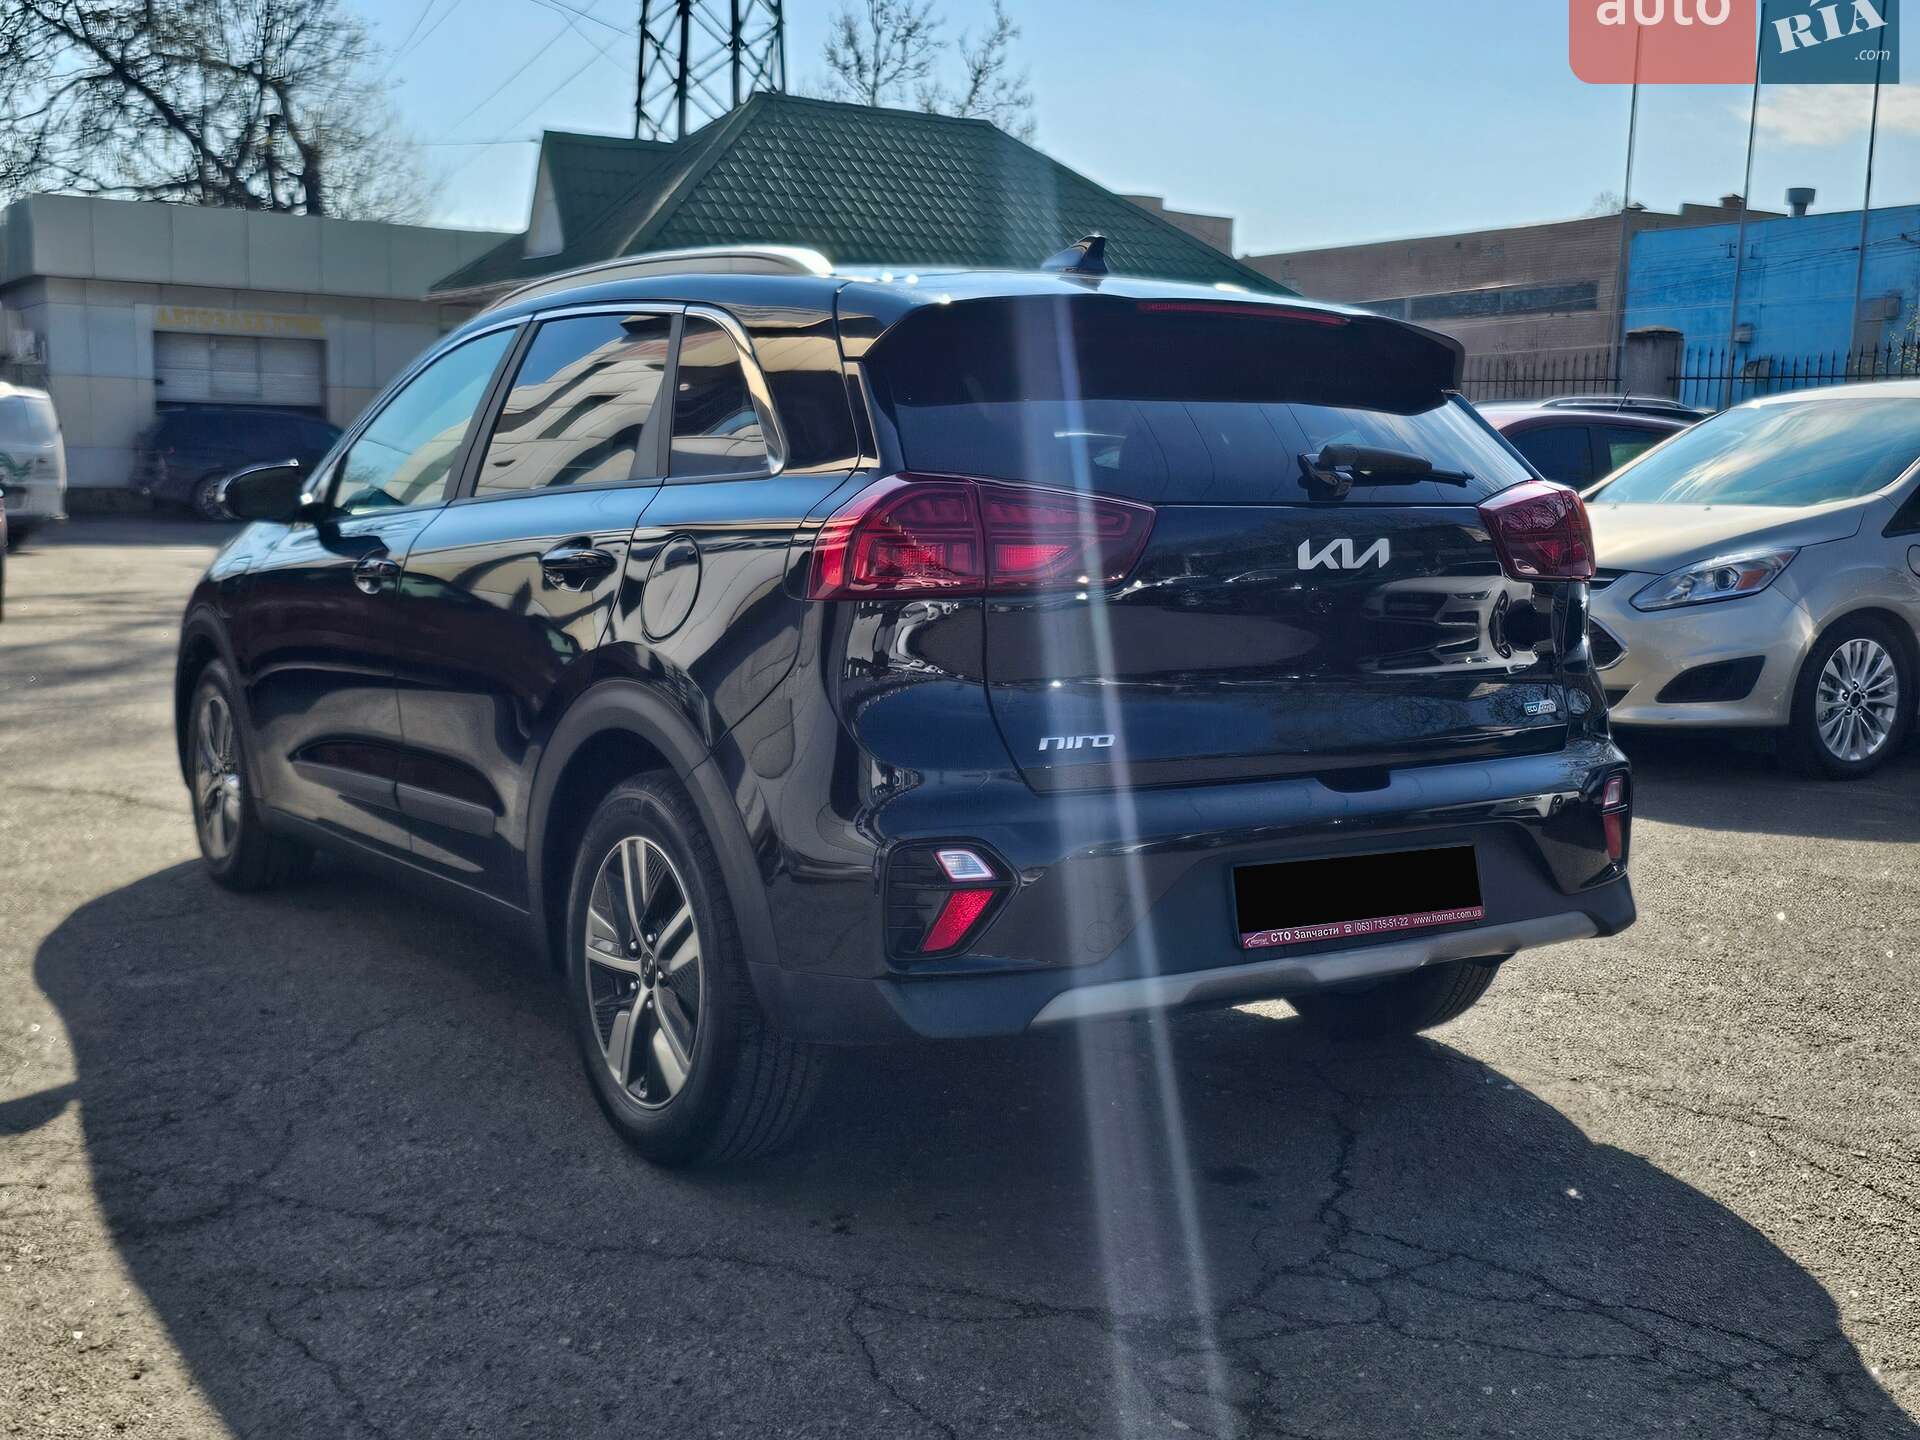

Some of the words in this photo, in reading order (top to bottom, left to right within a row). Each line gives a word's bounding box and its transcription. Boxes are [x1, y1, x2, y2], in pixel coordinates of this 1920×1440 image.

[1297, 538, 1390, 570] KIA
[1270, 931, 1291, 942] СТО
[1294, 926, 1340, 939] Запчасти
[1412, 909, 1482, 925] www.hornet.com.ua
